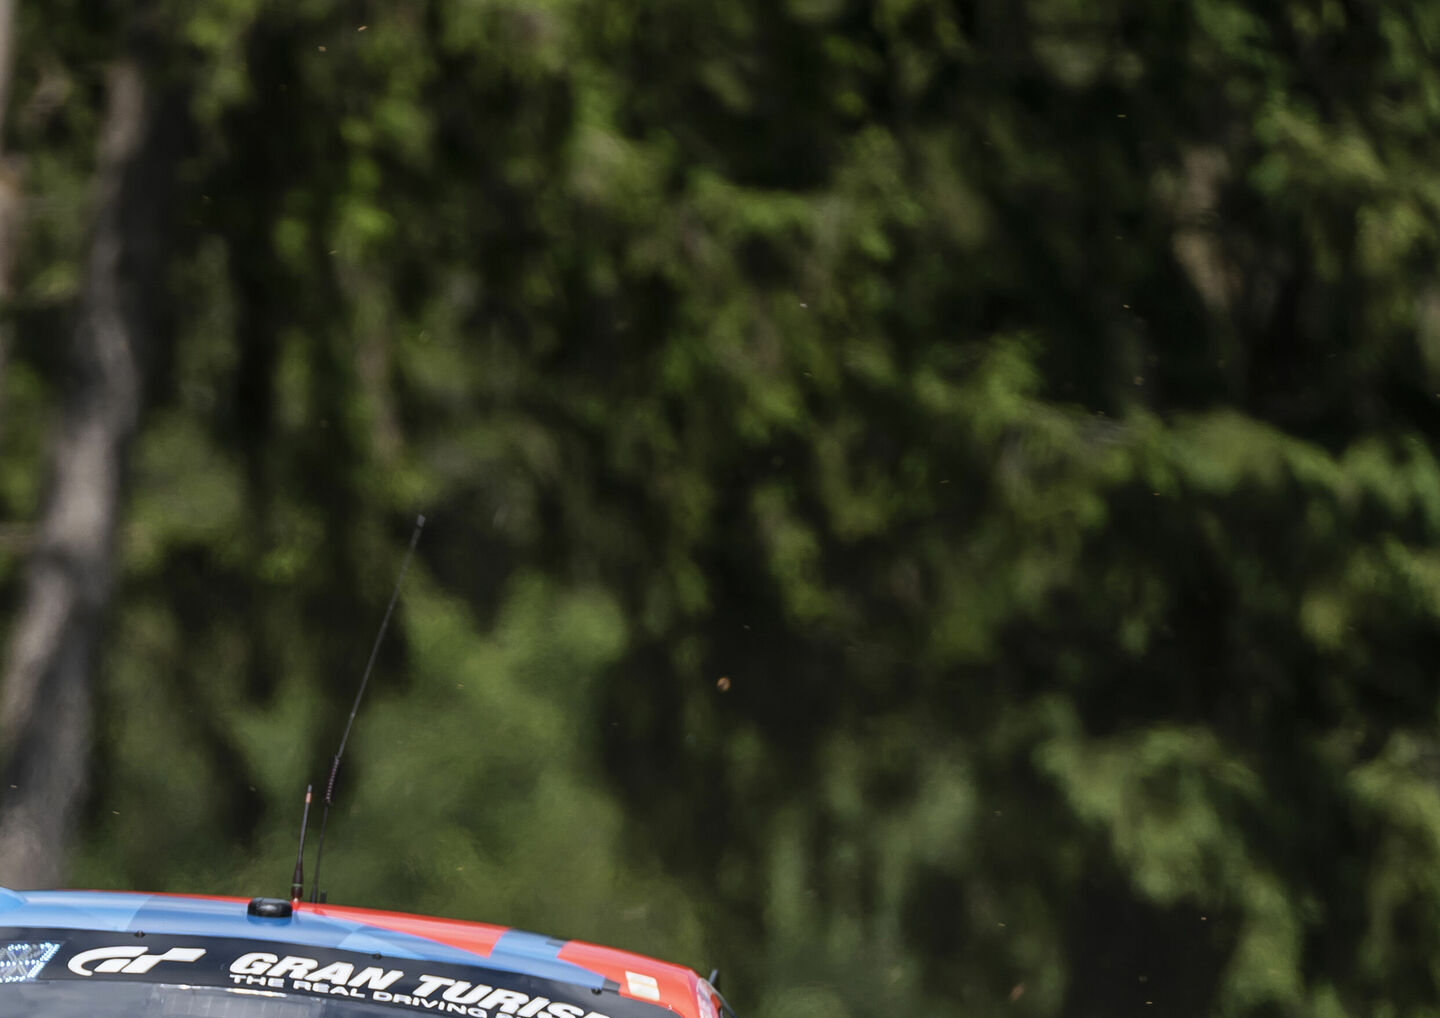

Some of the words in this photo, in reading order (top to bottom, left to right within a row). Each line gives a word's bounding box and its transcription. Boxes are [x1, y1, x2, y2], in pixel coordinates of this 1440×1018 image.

[228, 951, 405, 991] GRAN
[229, 973, 286, 989] THE
[292, 979, 366, 999] REAL
